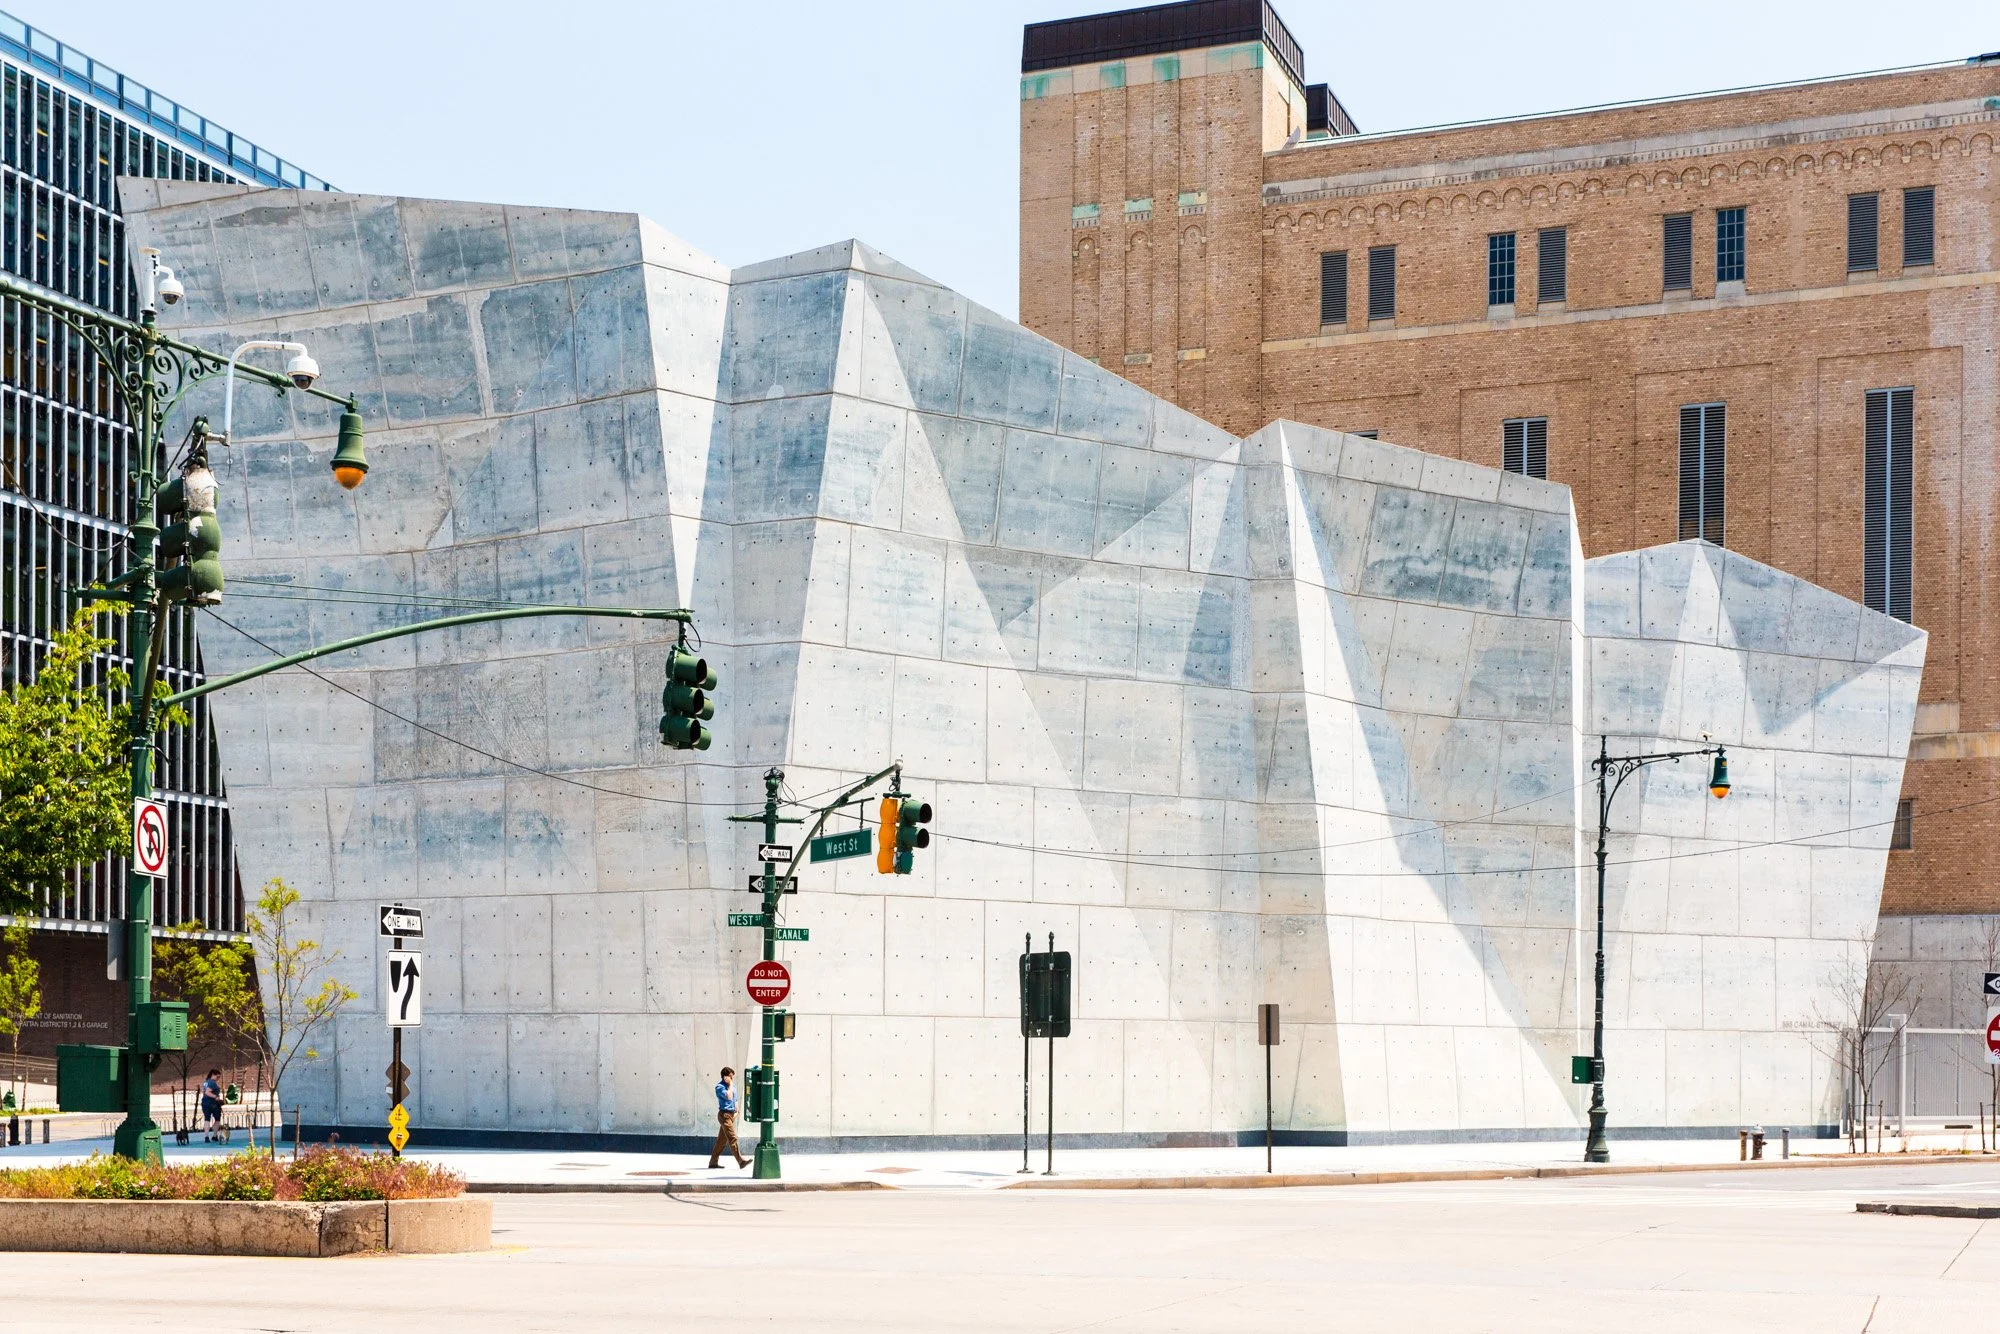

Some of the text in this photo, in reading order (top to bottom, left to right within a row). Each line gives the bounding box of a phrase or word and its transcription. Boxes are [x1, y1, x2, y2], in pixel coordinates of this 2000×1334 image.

[825, 838, 858, 855] West St
[763, 849, 789, 858] ONE WAY
[776, 881, 791, 889] WY
[387, 915, 419, 929] ONE WAY
[729, 915, 754, 926] WEST
[777, 929, 802, 940] CANAL
[754, 969, 783, 977] DO NOT
[755, 989, 781, 997] ENTER
[43, 1012, 51, 1020] OF
